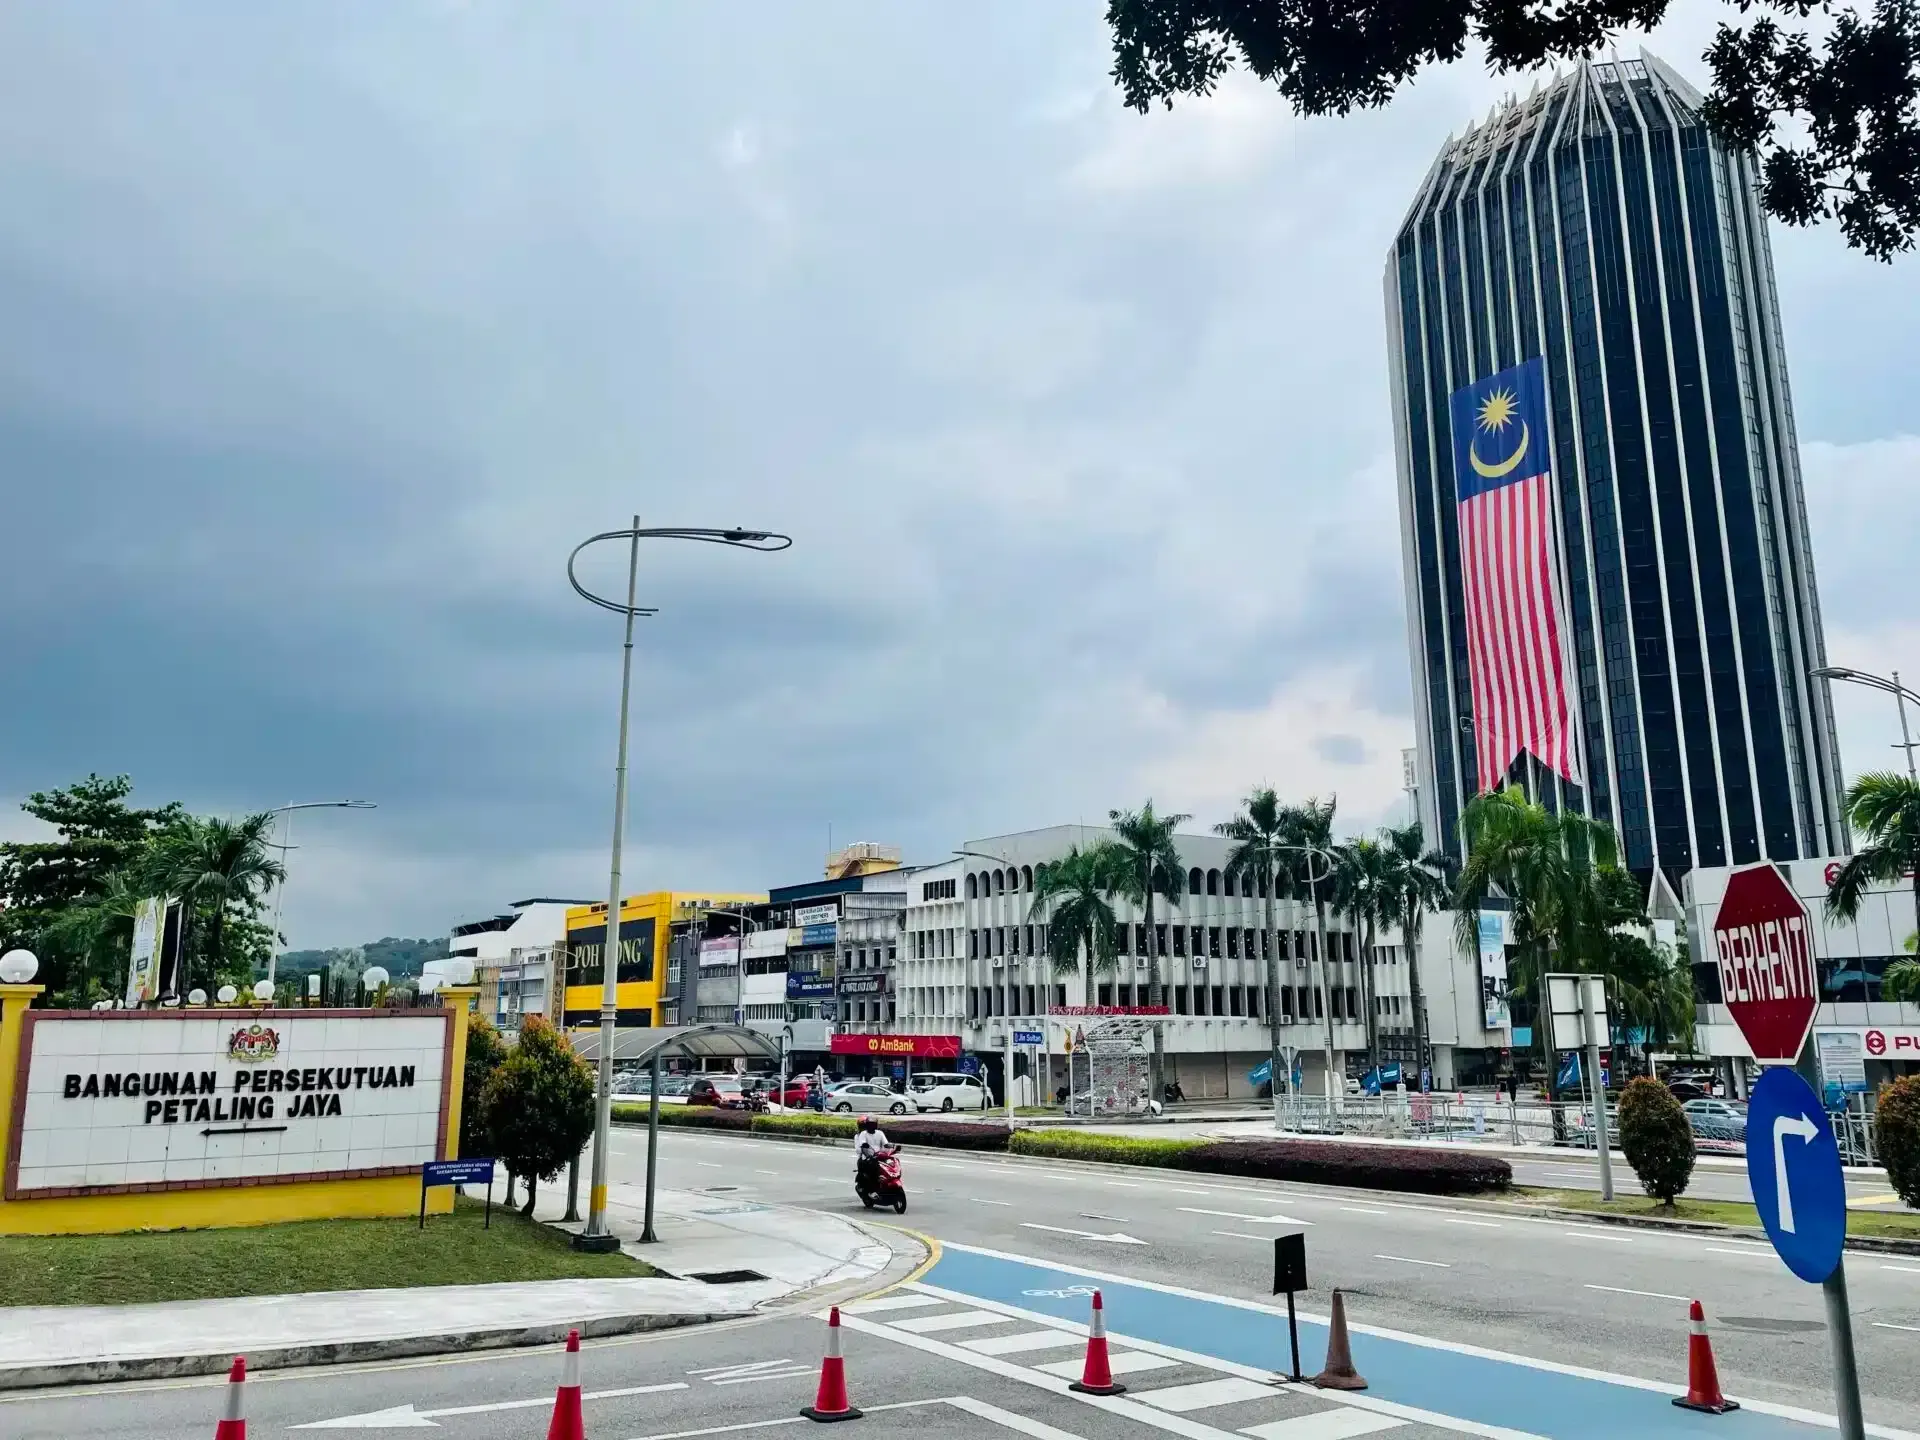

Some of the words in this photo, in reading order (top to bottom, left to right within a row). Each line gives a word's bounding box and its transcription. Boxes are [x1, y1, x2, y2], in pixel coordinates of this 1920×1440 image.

[575, 944, 600, 969] POH
[1716, 916, 1814, 1003] BERHENTI
[880, 1038, 914, 1052] AmBank
[63, 1071, 216, 1099] BANGUNAN
[233, 1065, 415, 1095] PERSEKUTUAN
[144, 1096, 274, 1124] PETALING
[288, 1093, 342, 1118] JAYA
